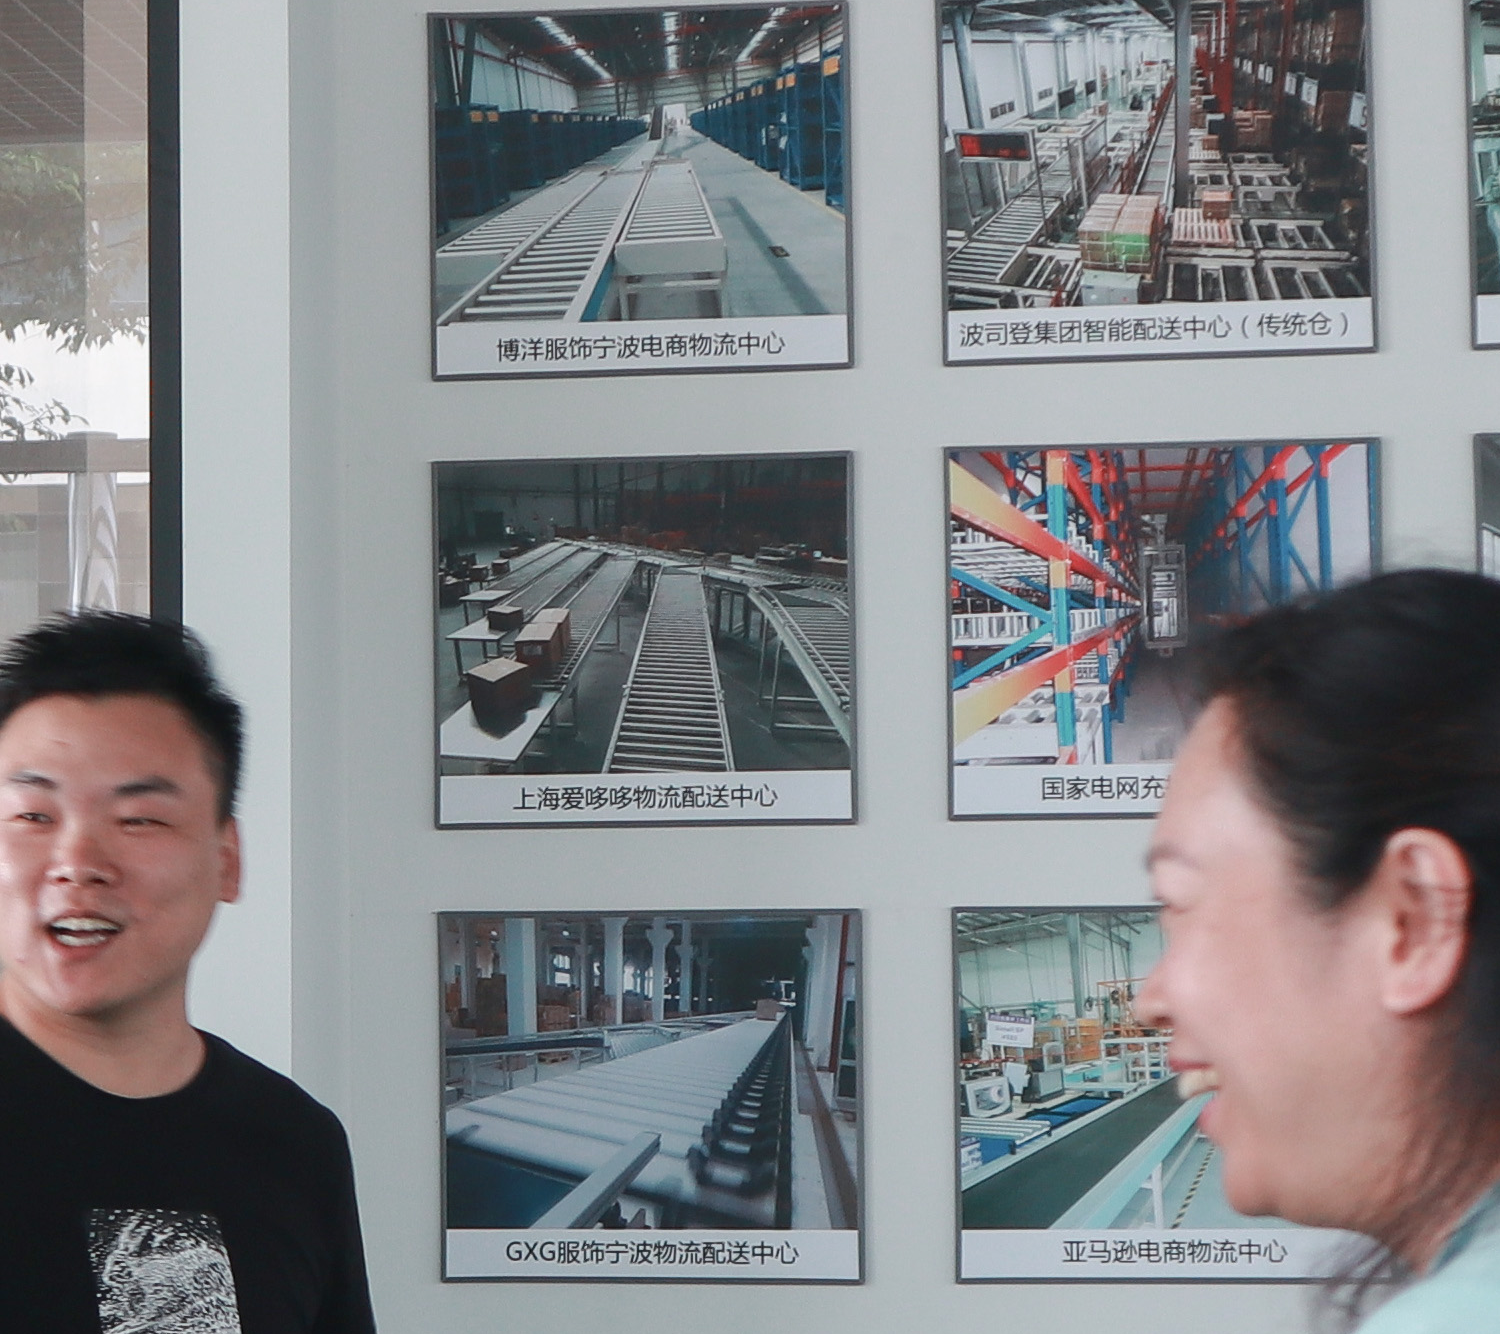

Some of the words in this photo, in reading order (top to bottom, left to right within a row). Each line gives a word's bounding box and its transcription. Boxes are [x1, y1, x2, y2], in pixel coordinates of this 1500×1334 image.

[496, 330, 786, 363] 博洋服饰宁波电商物流中心
[512, 784, 779, 812] 上海爱哆哆物流配送中心
[1041, 775, 1171, 801] 国家电网充
[505, 1240, 800, 1266] GXG服饰宁波物流配送中心
[1061, 1238, 1288, 1266] 亚马逊电商物流中心
